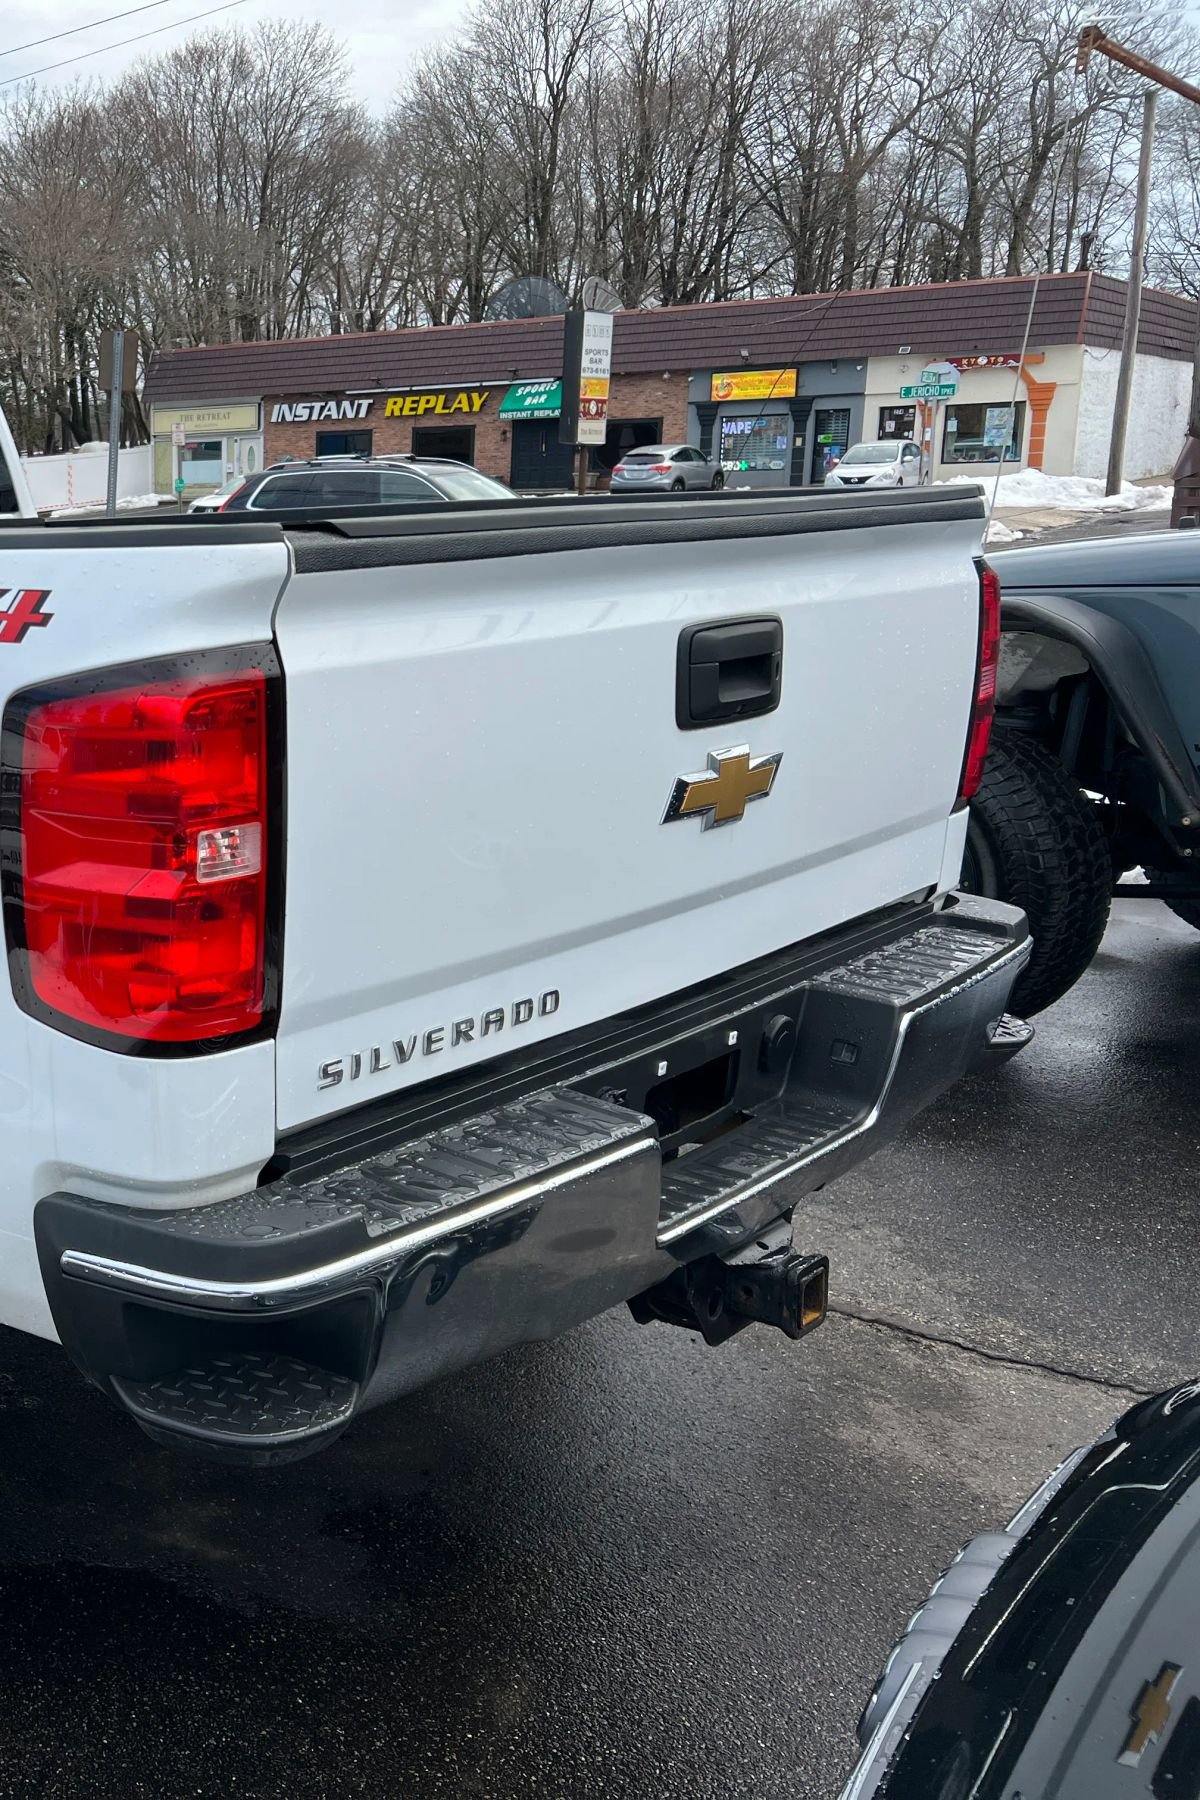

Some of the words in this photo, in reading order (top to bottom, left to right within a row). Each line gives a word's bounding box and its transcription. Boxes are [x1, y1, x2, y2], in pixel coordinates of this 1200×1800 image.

[589, 357, 603, 365] BAR
[515, 381, 559, 396] SPORTS
[901, 389, 906, 398] E
[909, 385, 940, 397] JERICHO
[523, 394, 547, 405] BAR
[270, 399, 373, 423] INSTANT
[385, 391, 489, 417] REPLAY
[180, 414, 194, 423] THE
[197, 412, 231, 421] RETREAT
[500, 411, 531, 419] INSTANT
[724, 421, 752, 434] VAPE
[317, 988, 561, 1091] SILVERADO
